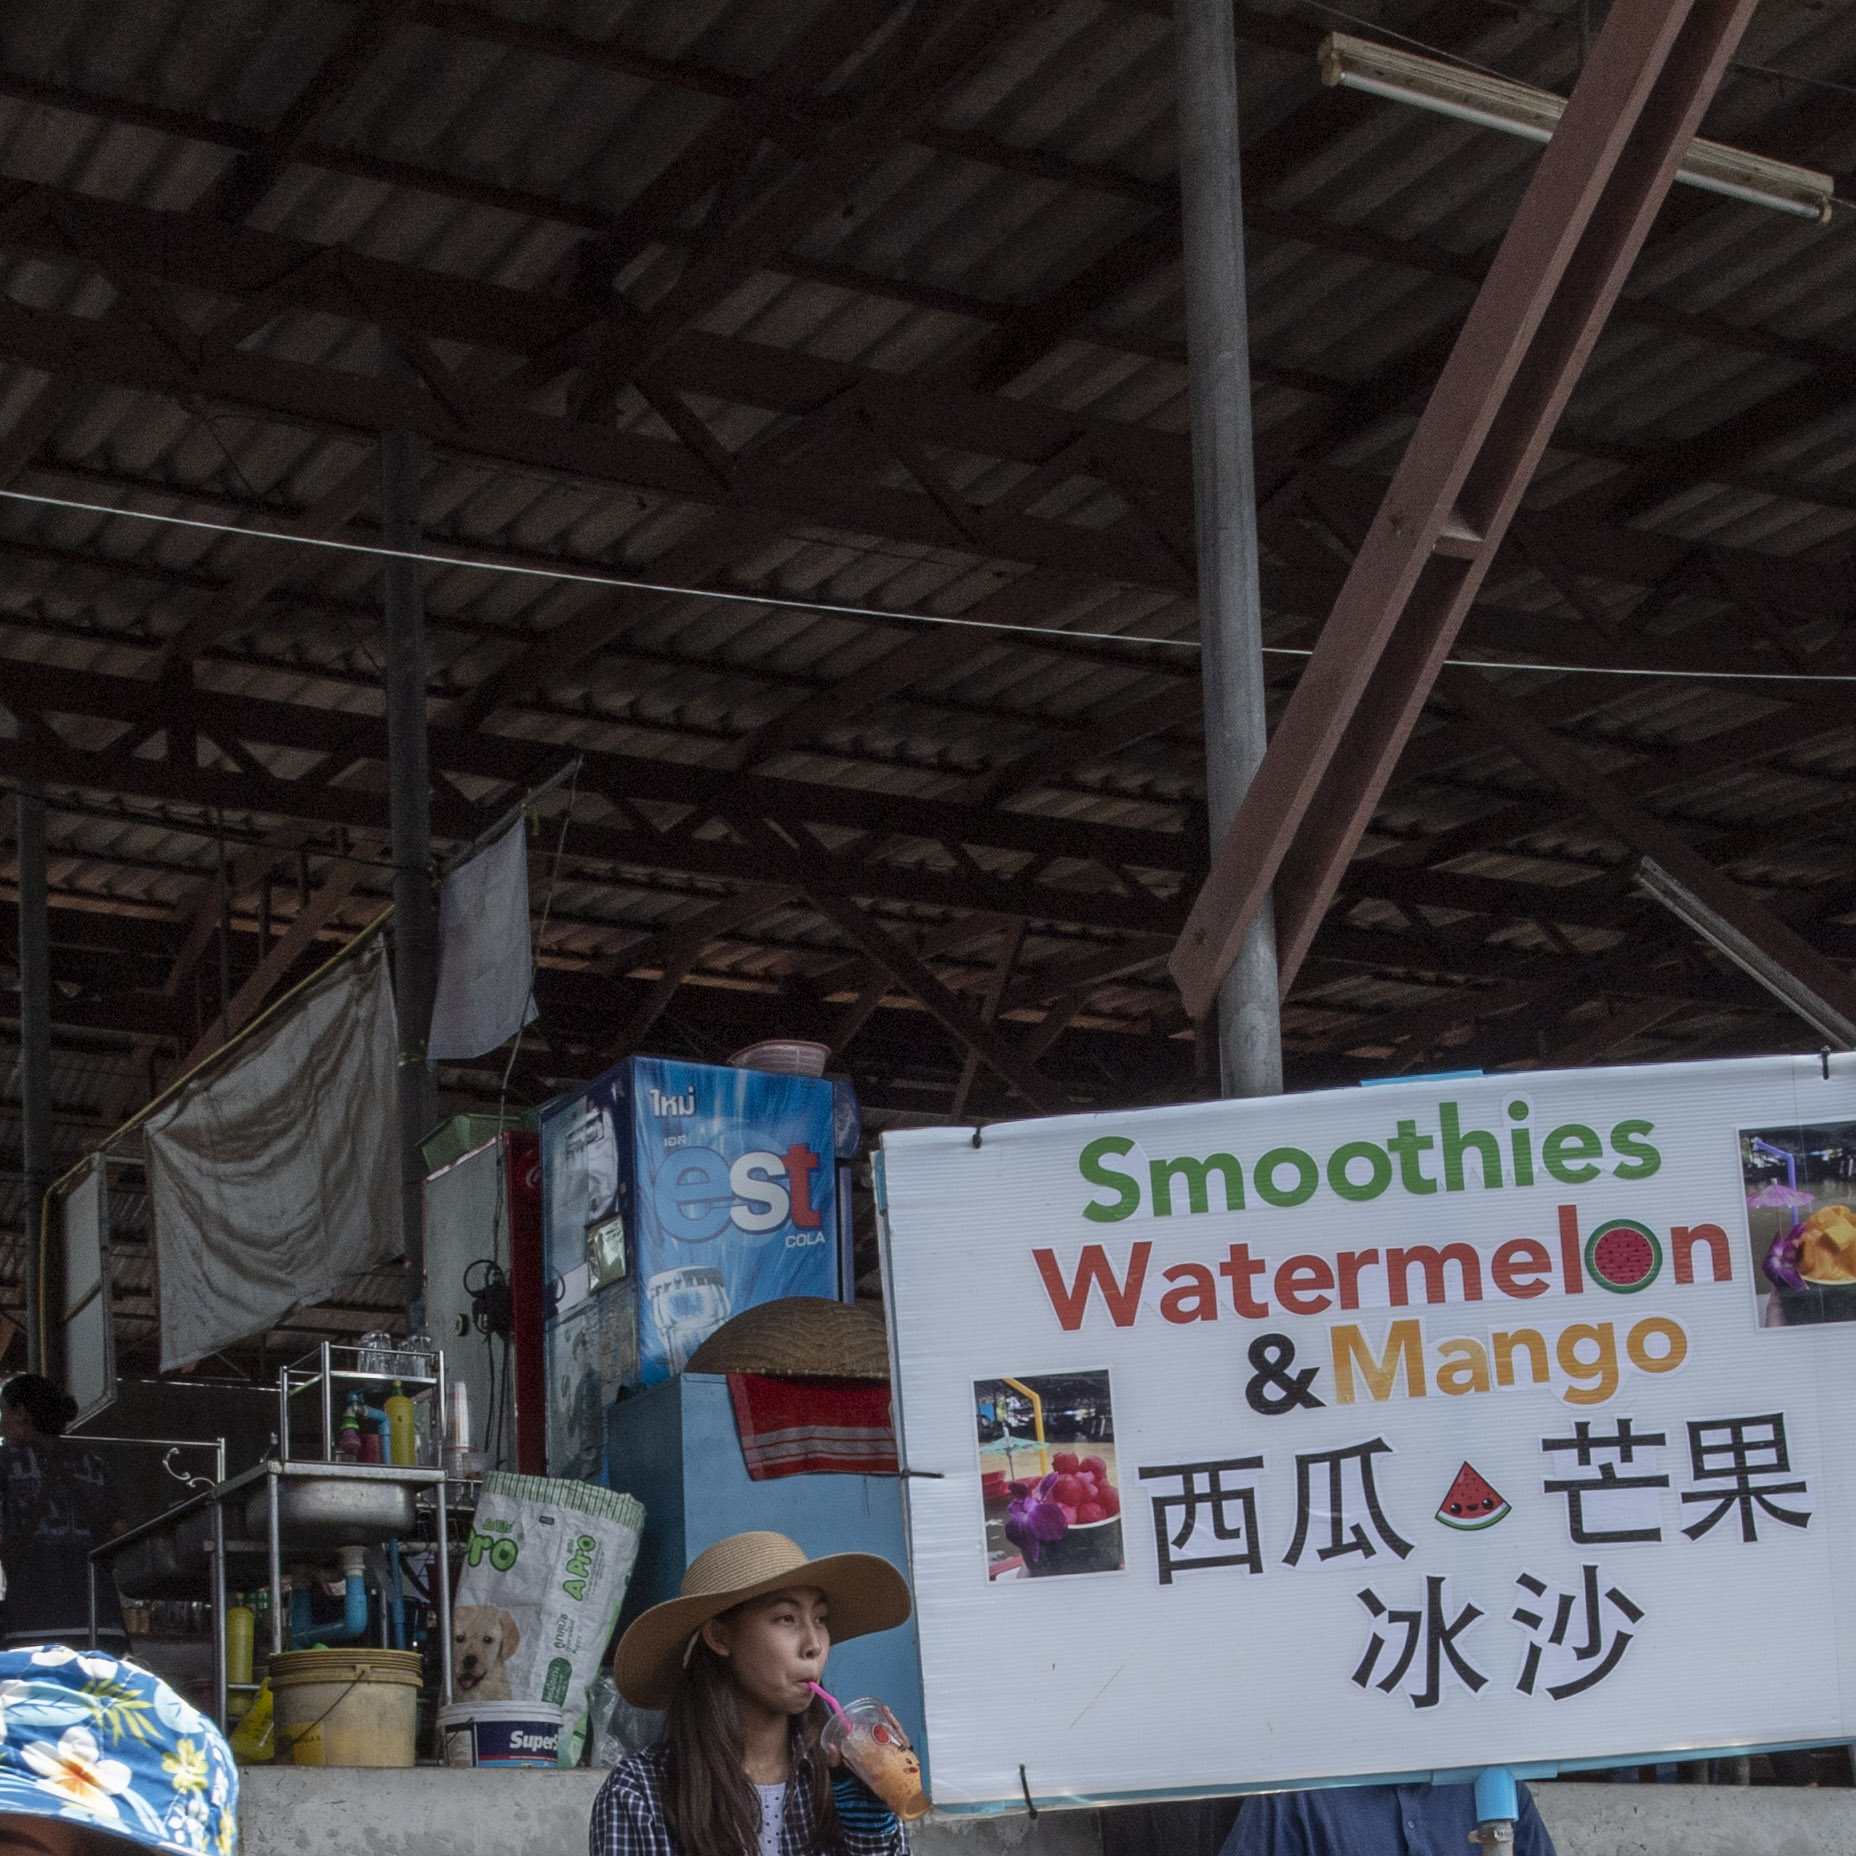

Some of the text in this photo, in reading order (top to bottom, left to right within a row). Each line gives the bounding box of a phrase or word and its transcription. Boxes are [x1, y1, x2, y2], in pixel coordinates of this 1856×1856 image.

[649, 1085, 696, 1117] ใหม่
[1076, 1100, 1663, 1224] Smoothies
[655, 1143, 821, 1243] est
[785, 1232, 826, 1248] COLA
[1032, 1204, 1732, 1331] Watermelon
[1138, 1411, 1813, 1586] 西瓜 芒果
[1350, 1562, 1644, 1709] 冰沙
